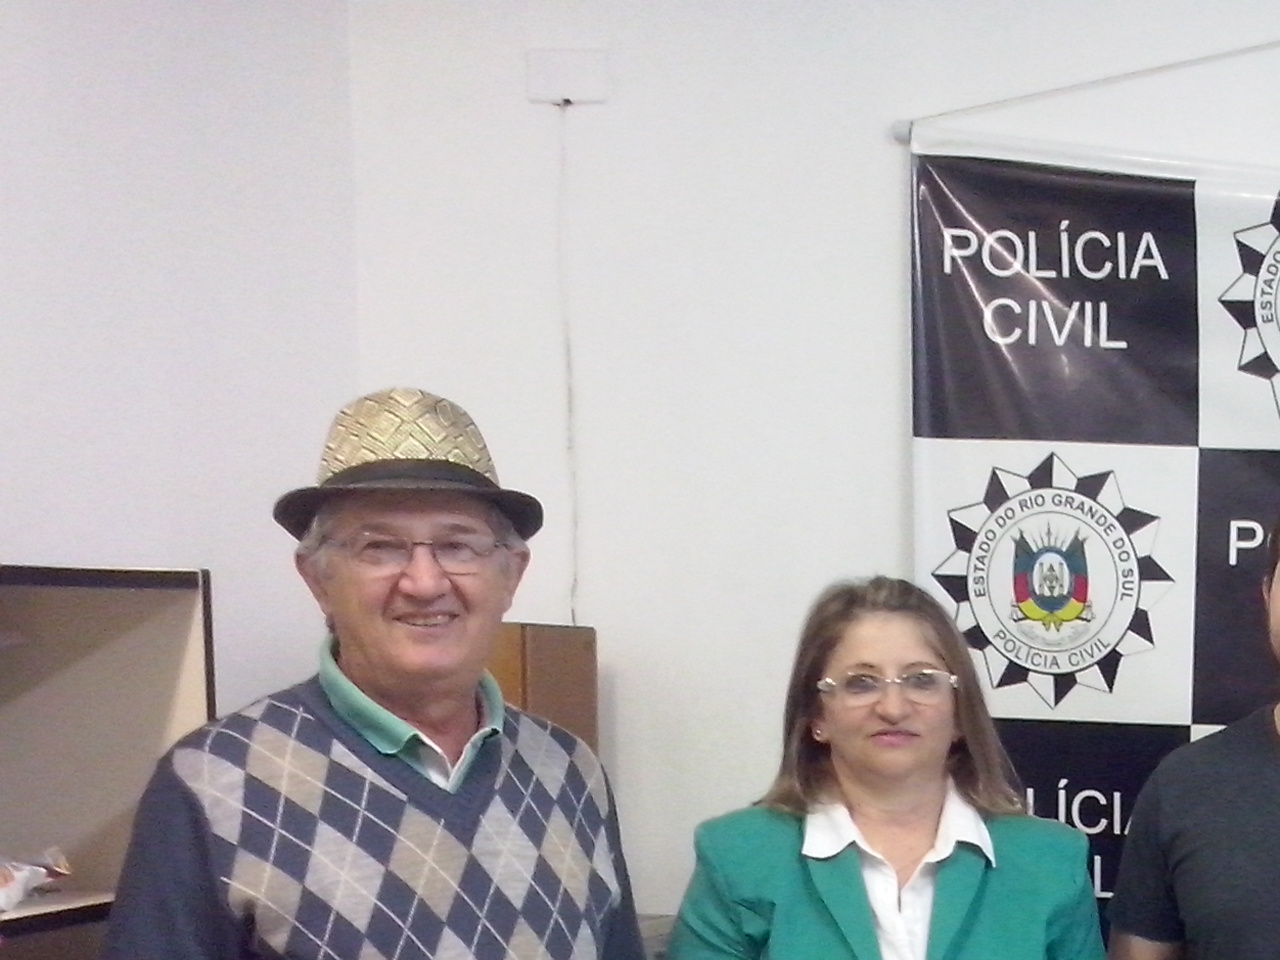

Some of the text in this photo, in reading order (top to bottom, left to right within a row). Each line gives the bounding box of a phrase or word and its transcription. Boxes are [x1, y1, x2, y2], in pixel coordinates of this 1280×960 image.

[942, 220, 1169, 281] POLÍCIA
[983, 298, 1128, 350] CIVIL
[973, 493, 1135, 601] ESTADO DO RIO GRANDE DO SUL
[1067, 637, 1111, 667] CIVIL
